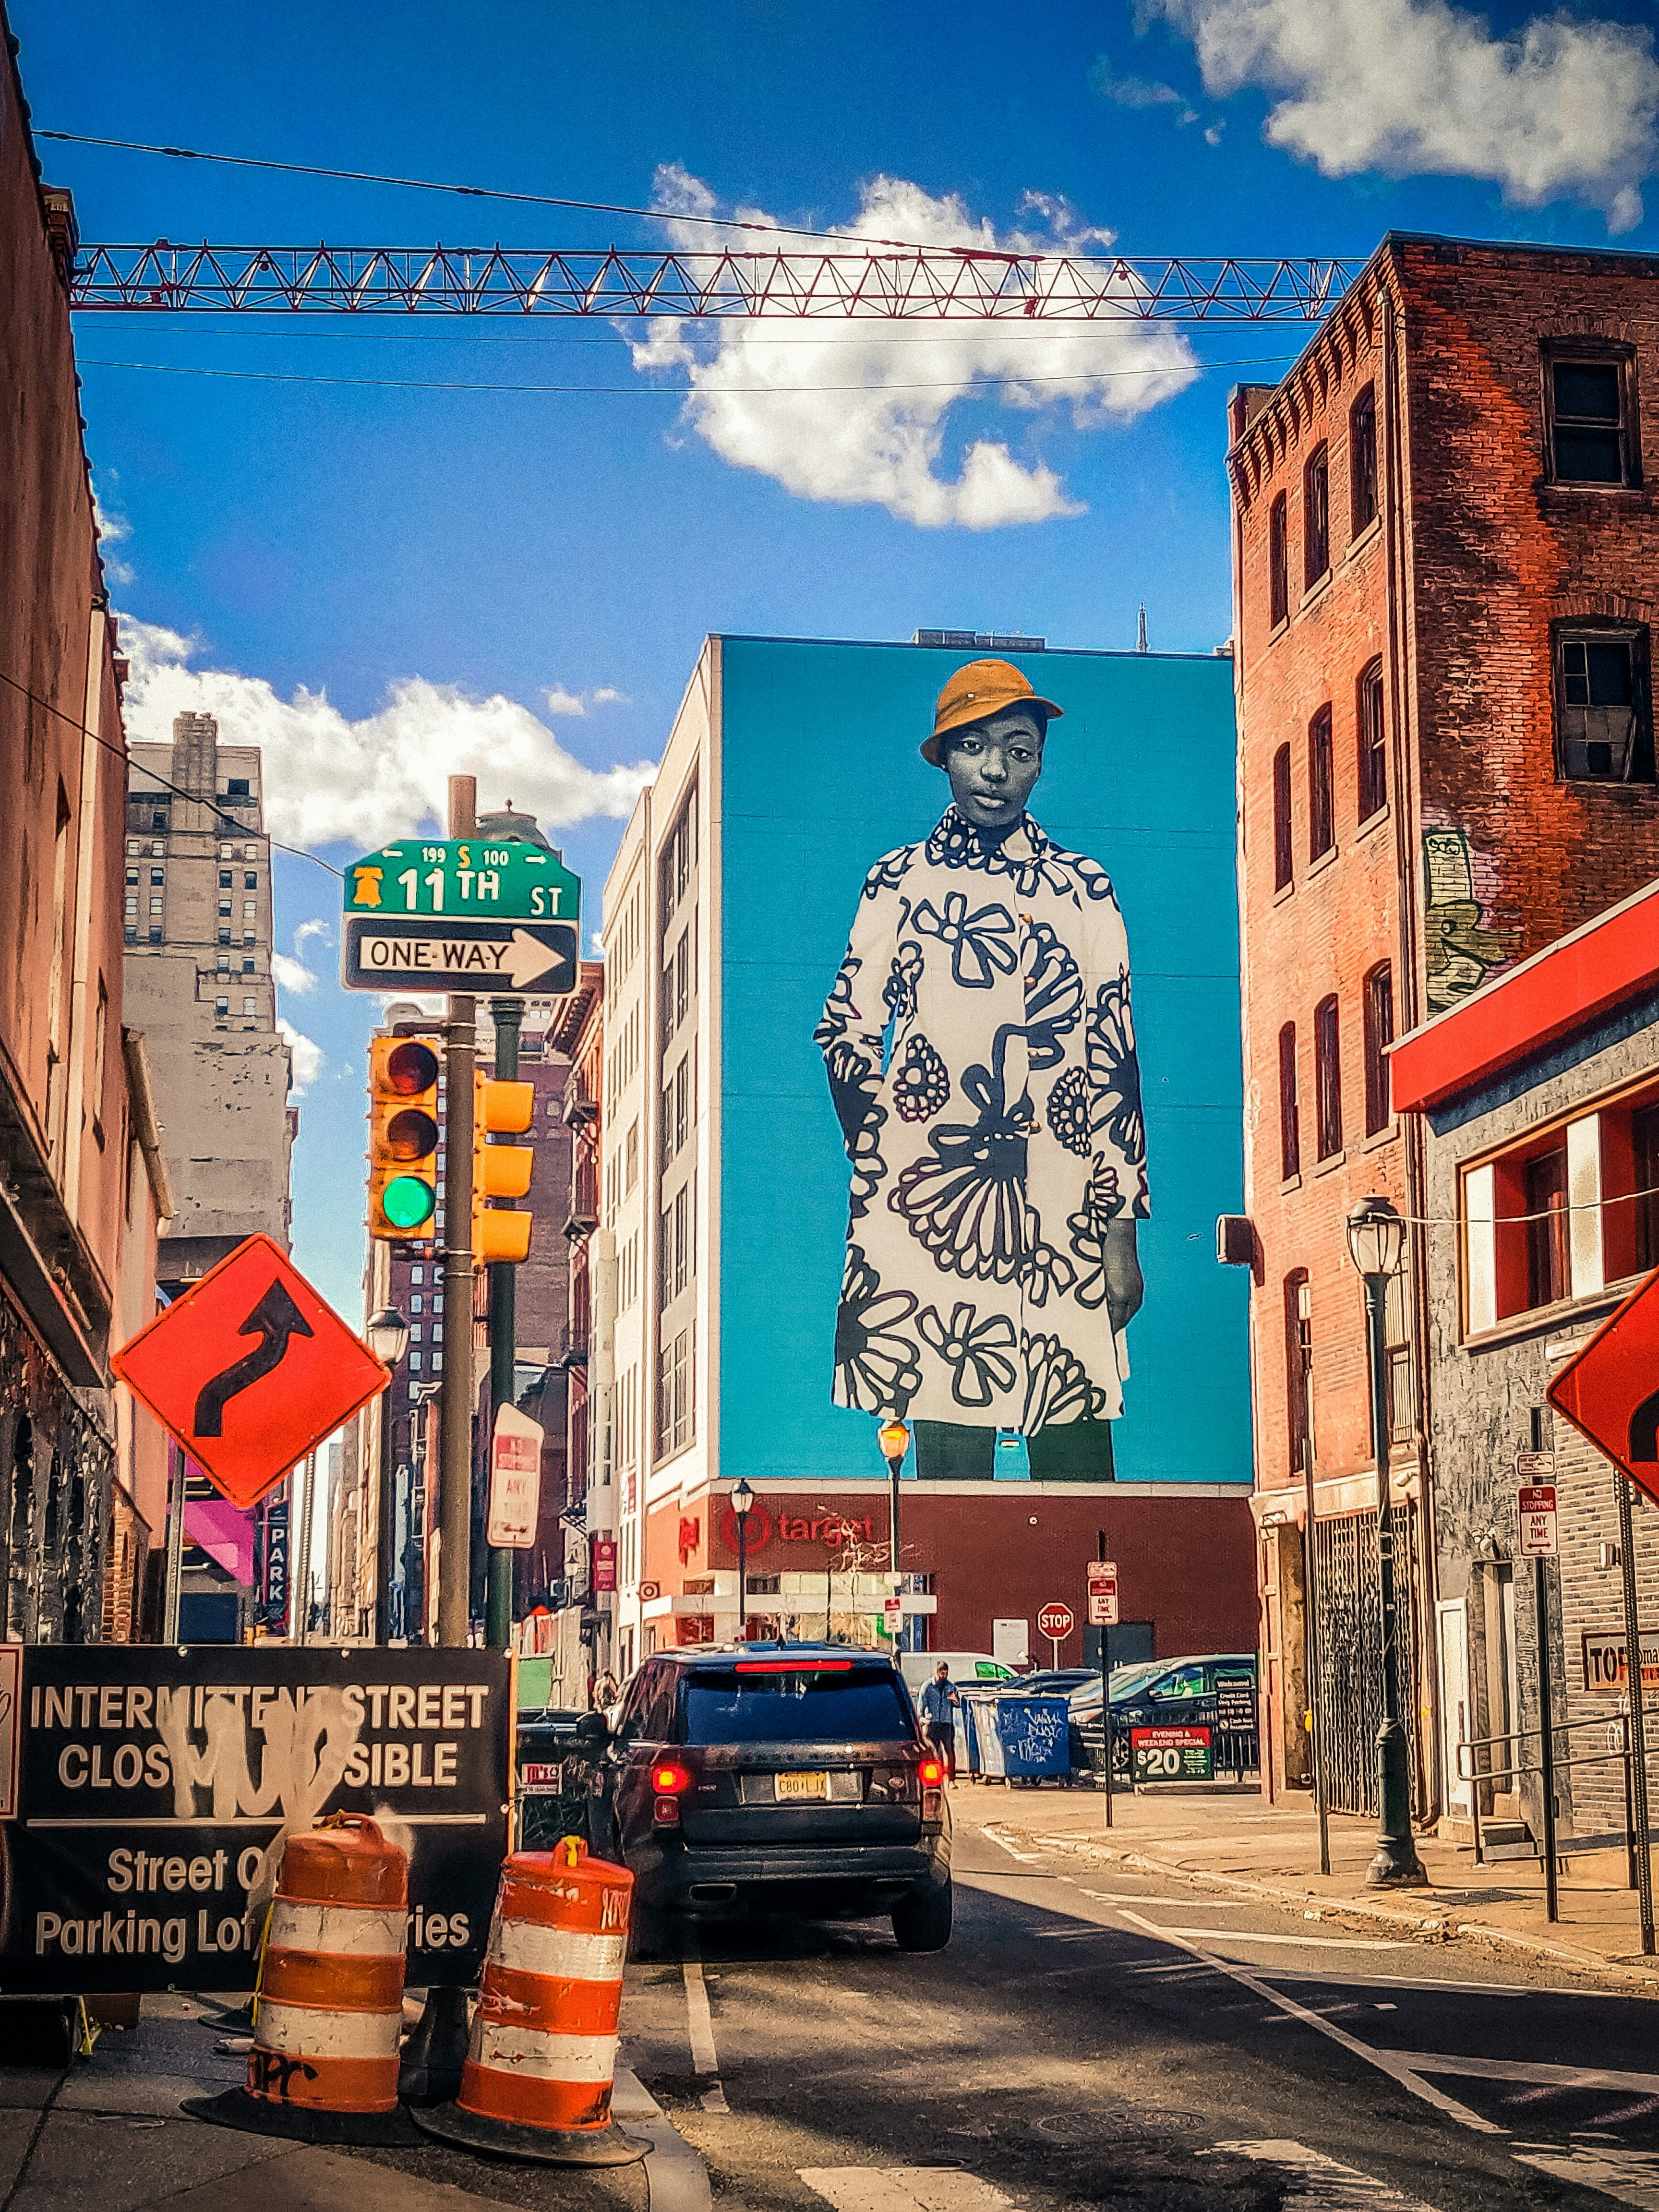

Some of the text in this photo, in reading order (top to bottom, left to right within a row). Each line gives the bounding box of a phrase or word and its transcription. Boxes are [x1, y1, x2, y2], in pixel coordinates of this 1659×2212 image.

[422, 845, 509, 868] 199 S 100
[530, 887, 563, 915] ST
[371, 940, 509, 970] ONE WAY
[1522, 1500, 1554, 1511] STOPPING
[1532, 1489, 1542, 1499] NO
[1530, 1515, 1548, 1527] ANY
[1530, 1527, 1549, 1539] TIME
[269, 1528, 285, 1601] PARK
[1041, 1614, 1070, 1629] STOP
[341, 1684, 490, 1729] STREET
[1175, 1737, 1206, 1746] SPECIAL
[1137, 1748, 1180, 1775] $20
[107, 1847, 228, 1893] Street
[36, 1909, 186, 1963] Parking
